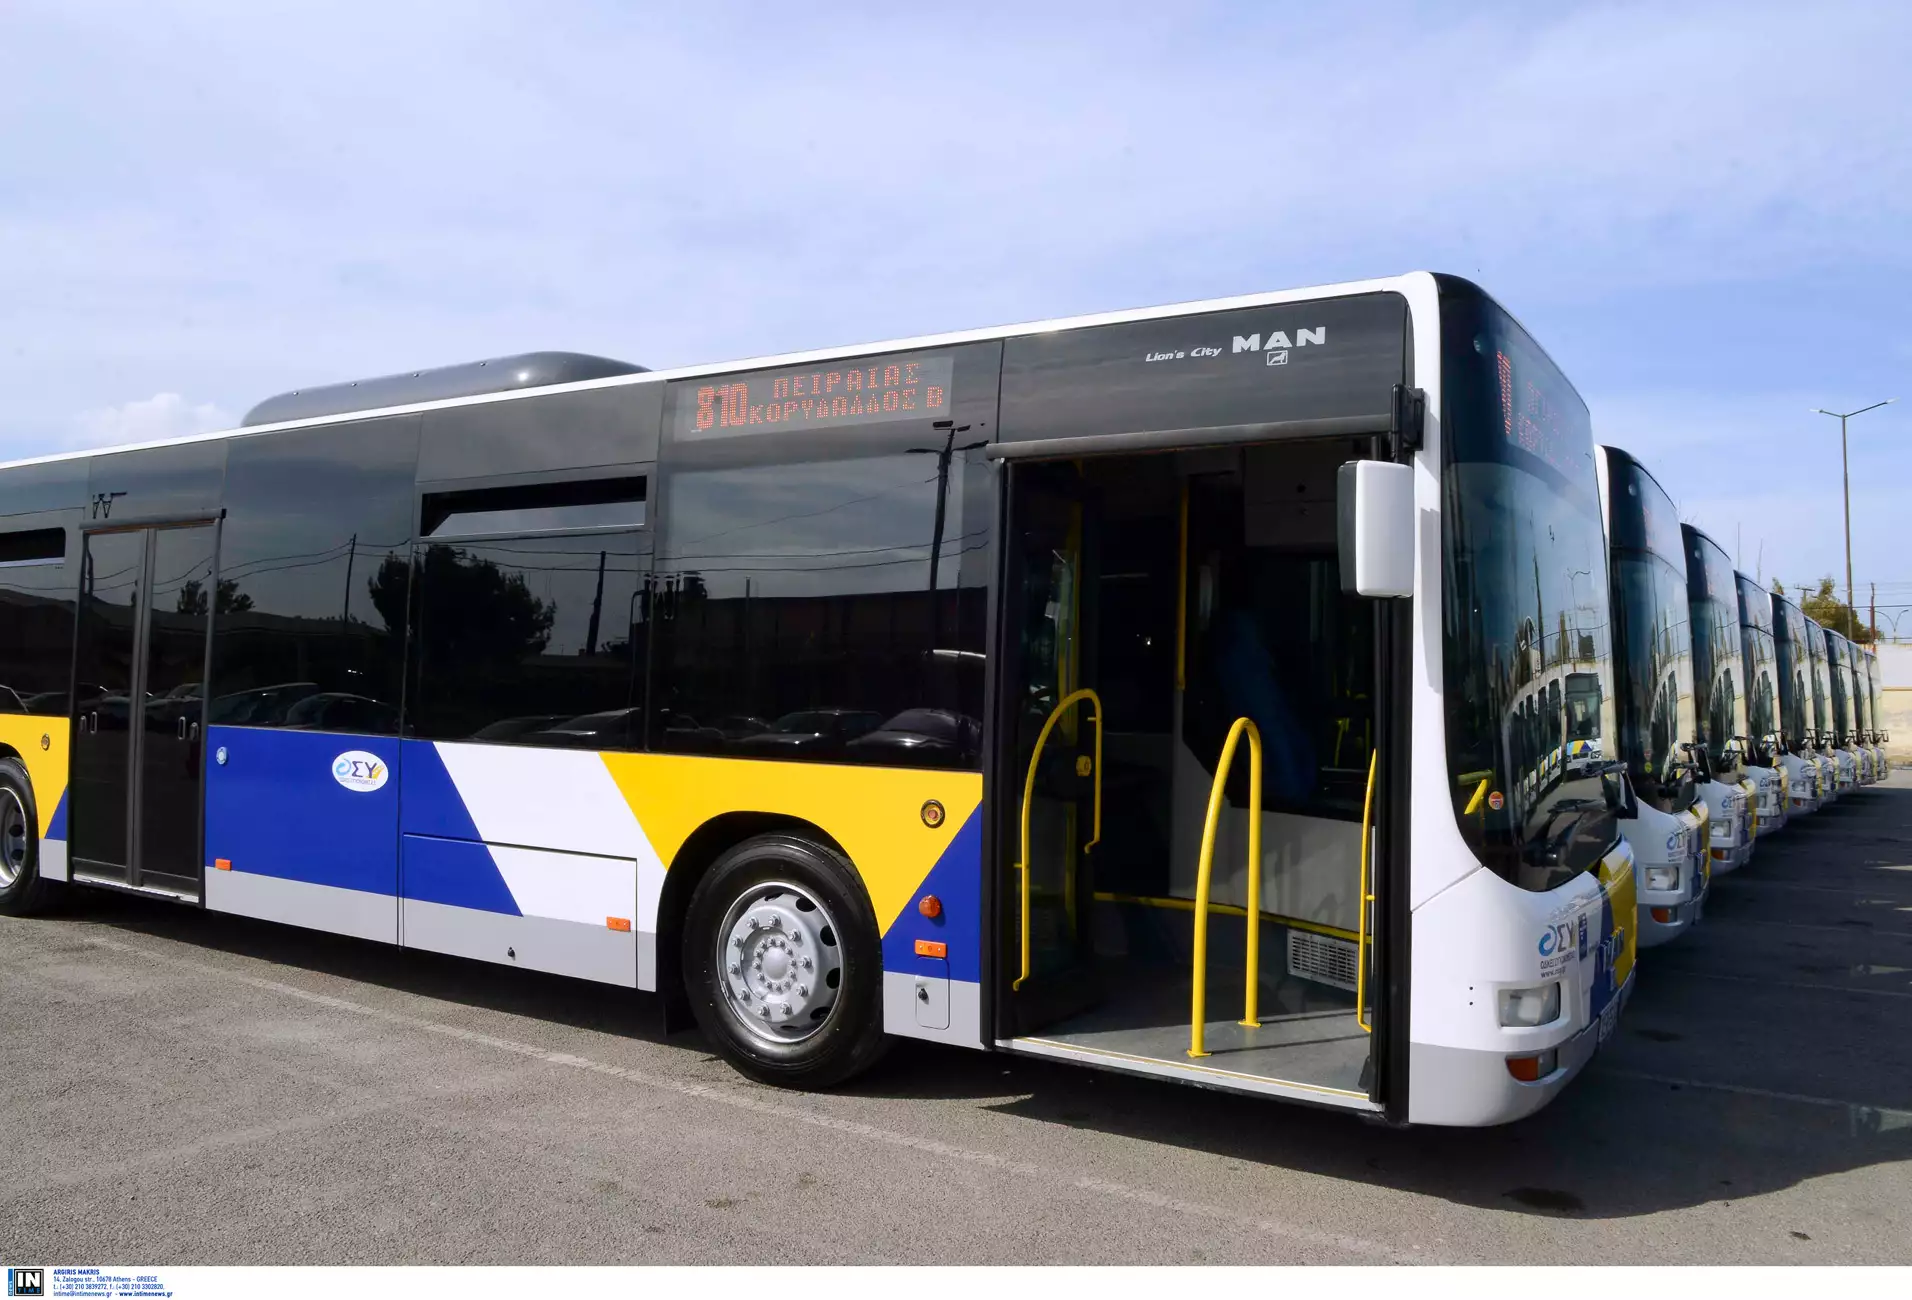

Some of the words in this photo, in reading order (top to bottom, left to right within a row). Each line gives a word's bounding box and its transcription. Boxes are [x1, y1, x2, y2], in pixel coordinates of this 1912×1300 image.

[1145, 349, 1185, 362] Lion's
[1191, 347, 1223, 358] City
[1232, 326, 1326, 353] MAN
[773, 362, 921, 399] ΠΕΙΡΑΙΑΣ
[696, 382, 748, 429] 810
